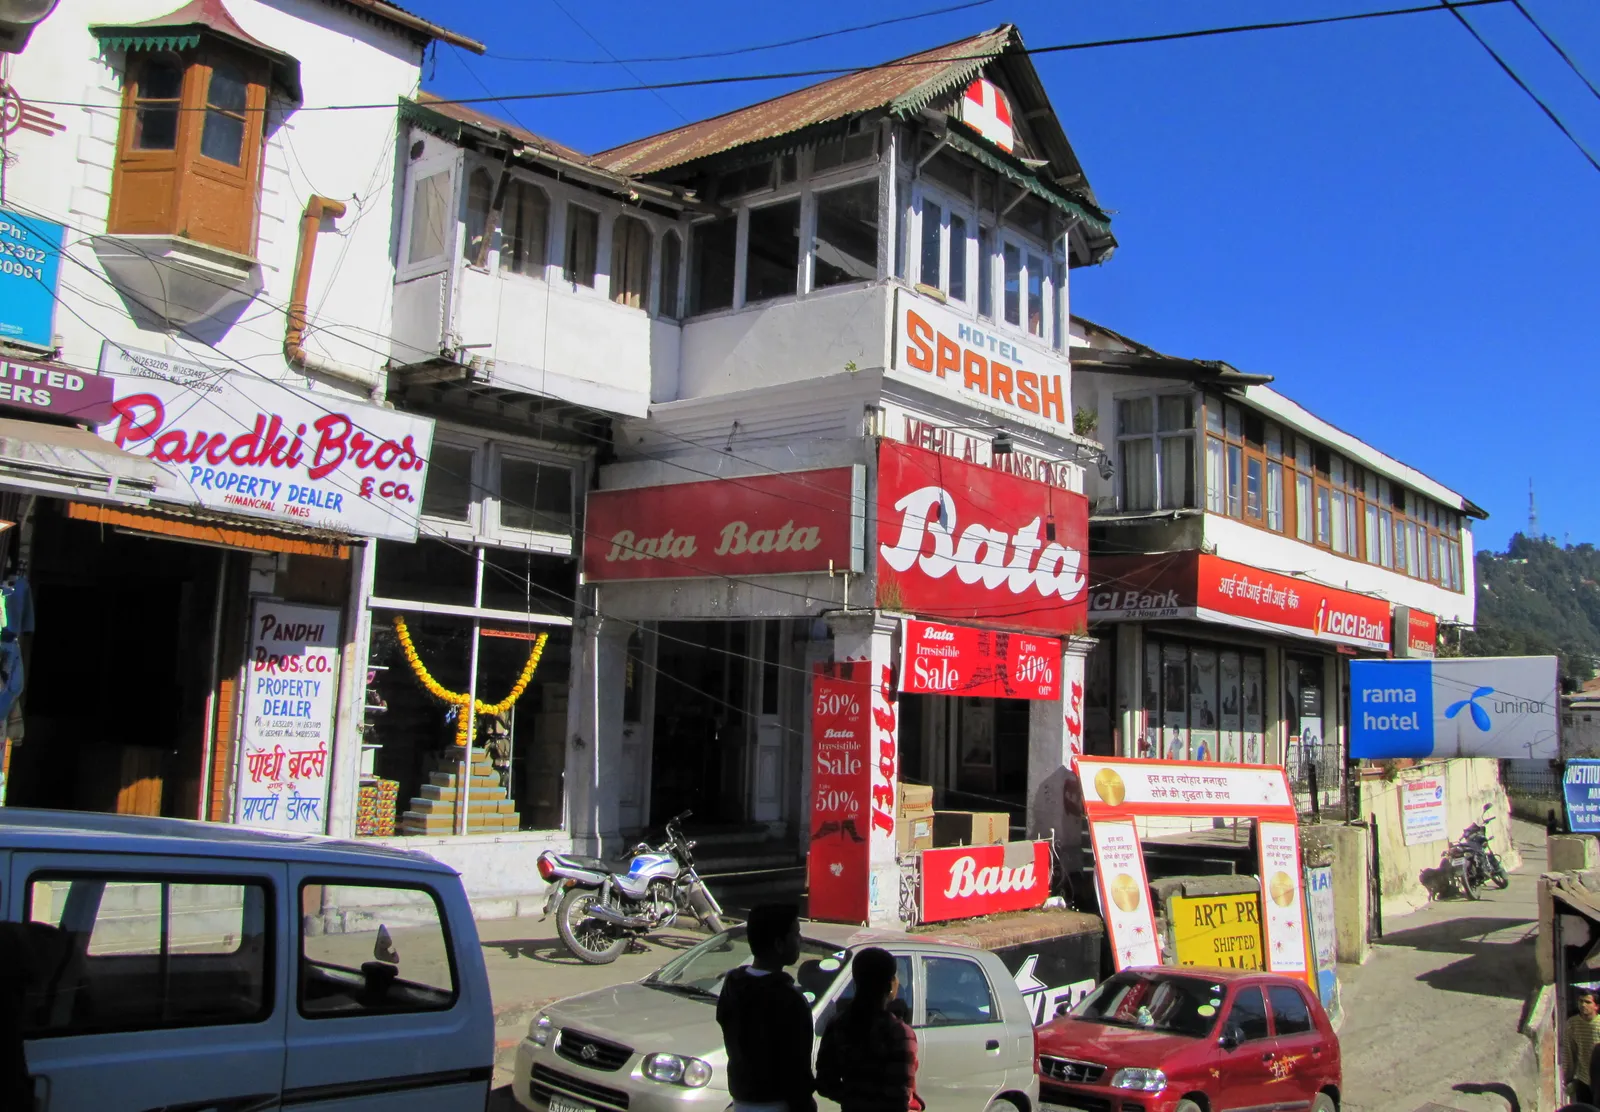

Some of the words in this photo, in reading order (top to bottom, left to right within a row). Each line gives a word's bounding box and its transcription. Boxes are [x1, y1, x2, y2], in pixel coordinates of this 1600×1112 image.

[0, 258, 42, 284] 0901
[958, 323, 1023, 365] HOTEL
[906, 308, 1065, 425] SPARSH
[0, 382, 52, 406] ERS
[111, 393, 308, 470] Pandhi
[307, 412, 424, 480] Bros.
[189, 465, 282, 501] PROPERTY
[288, 483, 344, 513] DEALER
[358, 476, 376, 500] &
[224, 493, 276, 512] HIMANCHAL
[283, 503, 311, 518] TIMES
[605, 528, 698, 563] Bata
[714, 518, 822, 557] Bata
[880, 486, 1086, 601] Bata
[1123, 589, 1179, 609] Bank
[1139, 609, 1158, 617] Hour
[1160, 608, 1178, 616] ATM
[259, 614, 325, 643] PANDHI
[923, 627, 954, 641] Bata
[1327, 610, 1358, 636] ICICI
[1358, 615, 1384, 641] Bank
[916, 643, 960, 658] Irresistible
[1020, 640, 1037, 653] Upto
[914, 657, 959, 690] Sale
[1016, 655, 1052, 683] 50%
[256, 677, 321, 698] PROPERTY
[1362, 688, 1417, 703] rama
[262, 698, 312, 719] DEALER
[816, 694, 859, 715] 50%
[1494, 697, 1546, 714] uninor
[1364, 712, 1419, 730] hotel
[824, 729, 854, 738] Bata
[818, 741, 861, 751] Irresistible
[288, 741, 328, 780] ब्रदर्स
[817, 751, 861, 776] Sale
[1147, 774, 1160, 785] इस
[816, 790, 859, 812] 50%
[1151, 786, 1168, 798] सोने
[1169, 786, 1180, 798] की
[286, 791, 321, 823] डीलर
[944, 856, 1037, 899] Bata
[1194, 903, 1228, 928] ART
[1235, 901, 1259, 925] PR
[1213, 934, 1255, 953] SHIFTED
